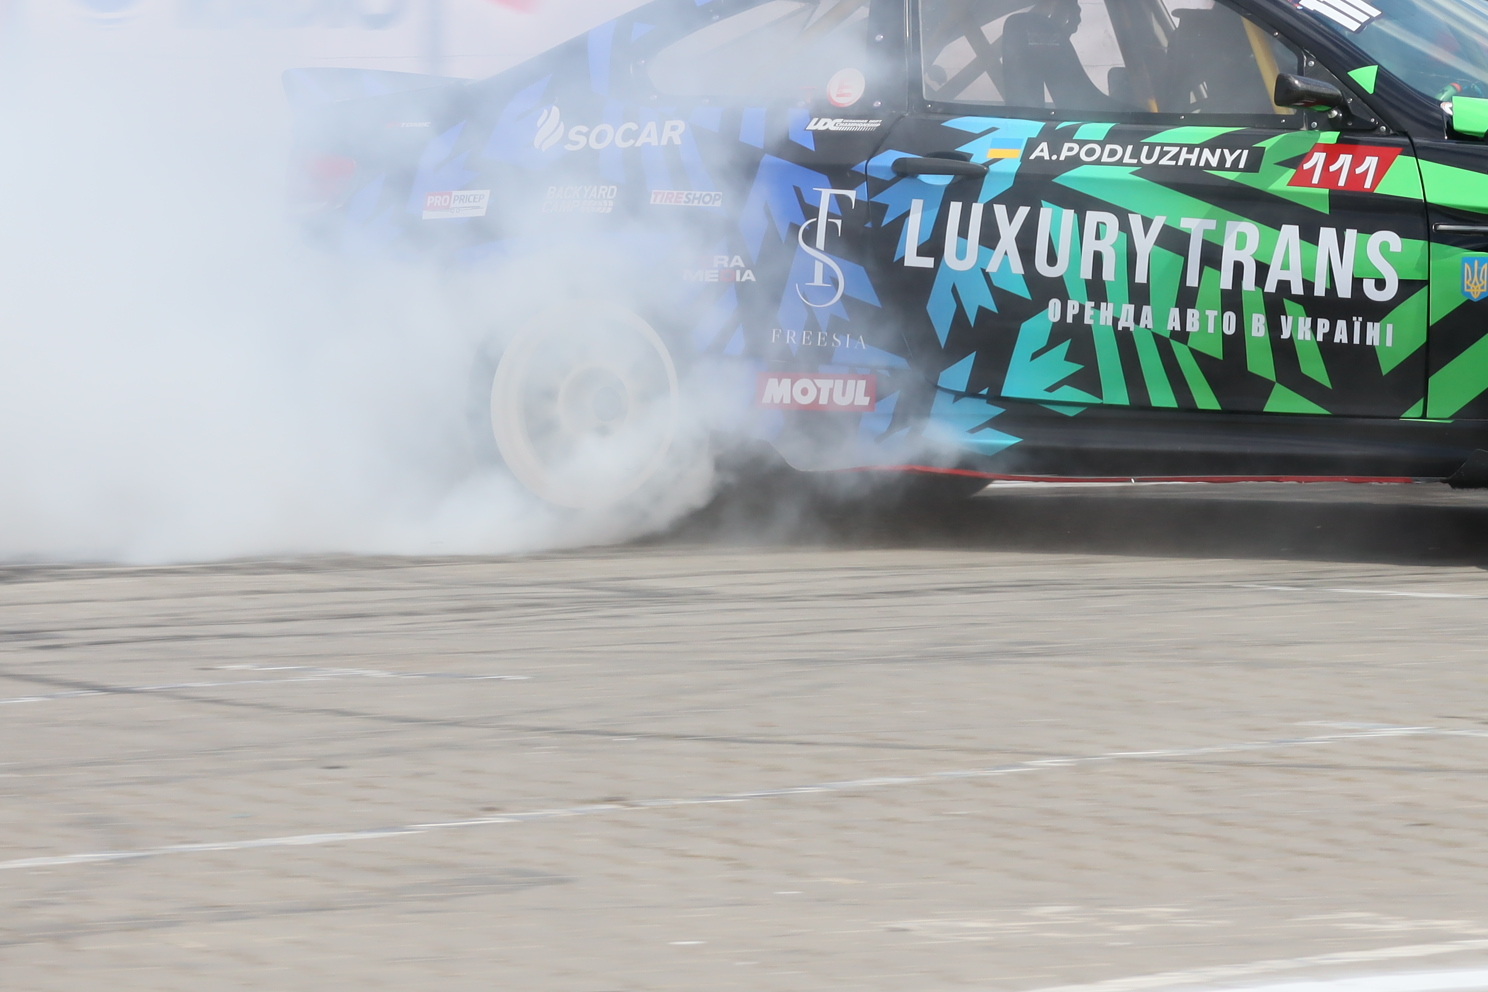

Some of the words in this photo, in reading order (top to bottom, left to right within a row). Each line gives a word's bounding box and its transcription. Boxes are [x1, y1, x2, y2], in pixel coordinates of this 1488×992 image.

[566, 120, 686, 151] SOCAR
[1029, 141, 1249, 170] A.PODLUZHNYI
[1302, 152, 1379, 189] 111
[546, 185, 618, 200] BACKYARD
[903, 198, 1168, 284] LUXURY
[1179, 216, 1403, 302] TRANS
[1047, 298, 1154, 332] ОРЕНДА
[1167, 307, 1237, 336] АВТО
[1251, 313, 1267, 338] В
[1280, 314, 1394, 347] УКРАЇНІ
[771, 327, 868, 350] FREESIA
[761, 377, 871, 406] MOTUL
